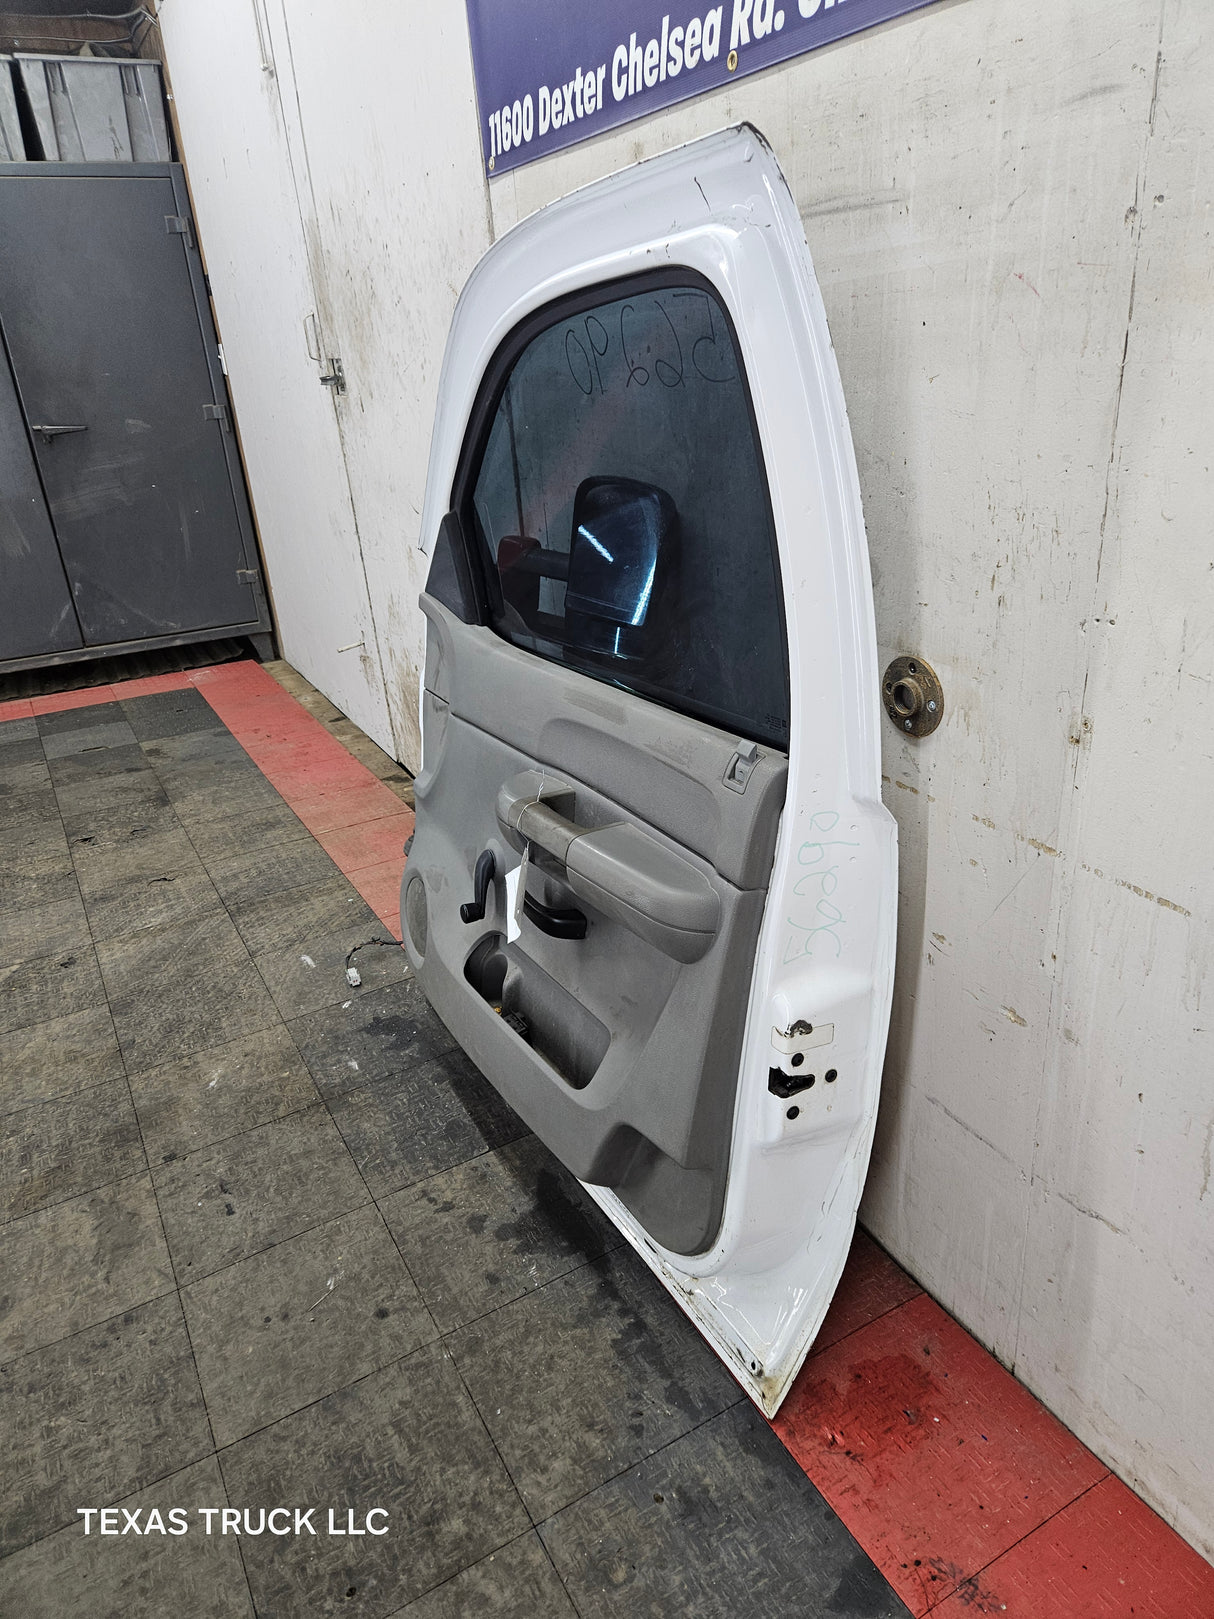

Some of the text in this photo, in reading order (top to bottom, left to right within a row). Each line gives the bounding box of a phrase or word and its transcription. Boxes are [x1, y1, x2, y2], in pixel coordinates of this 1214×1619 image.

[488, 93, 534, 158] 11600
[538, 63, 606, 136] Dexter
[611, 5, 722, 101] Chelsea
